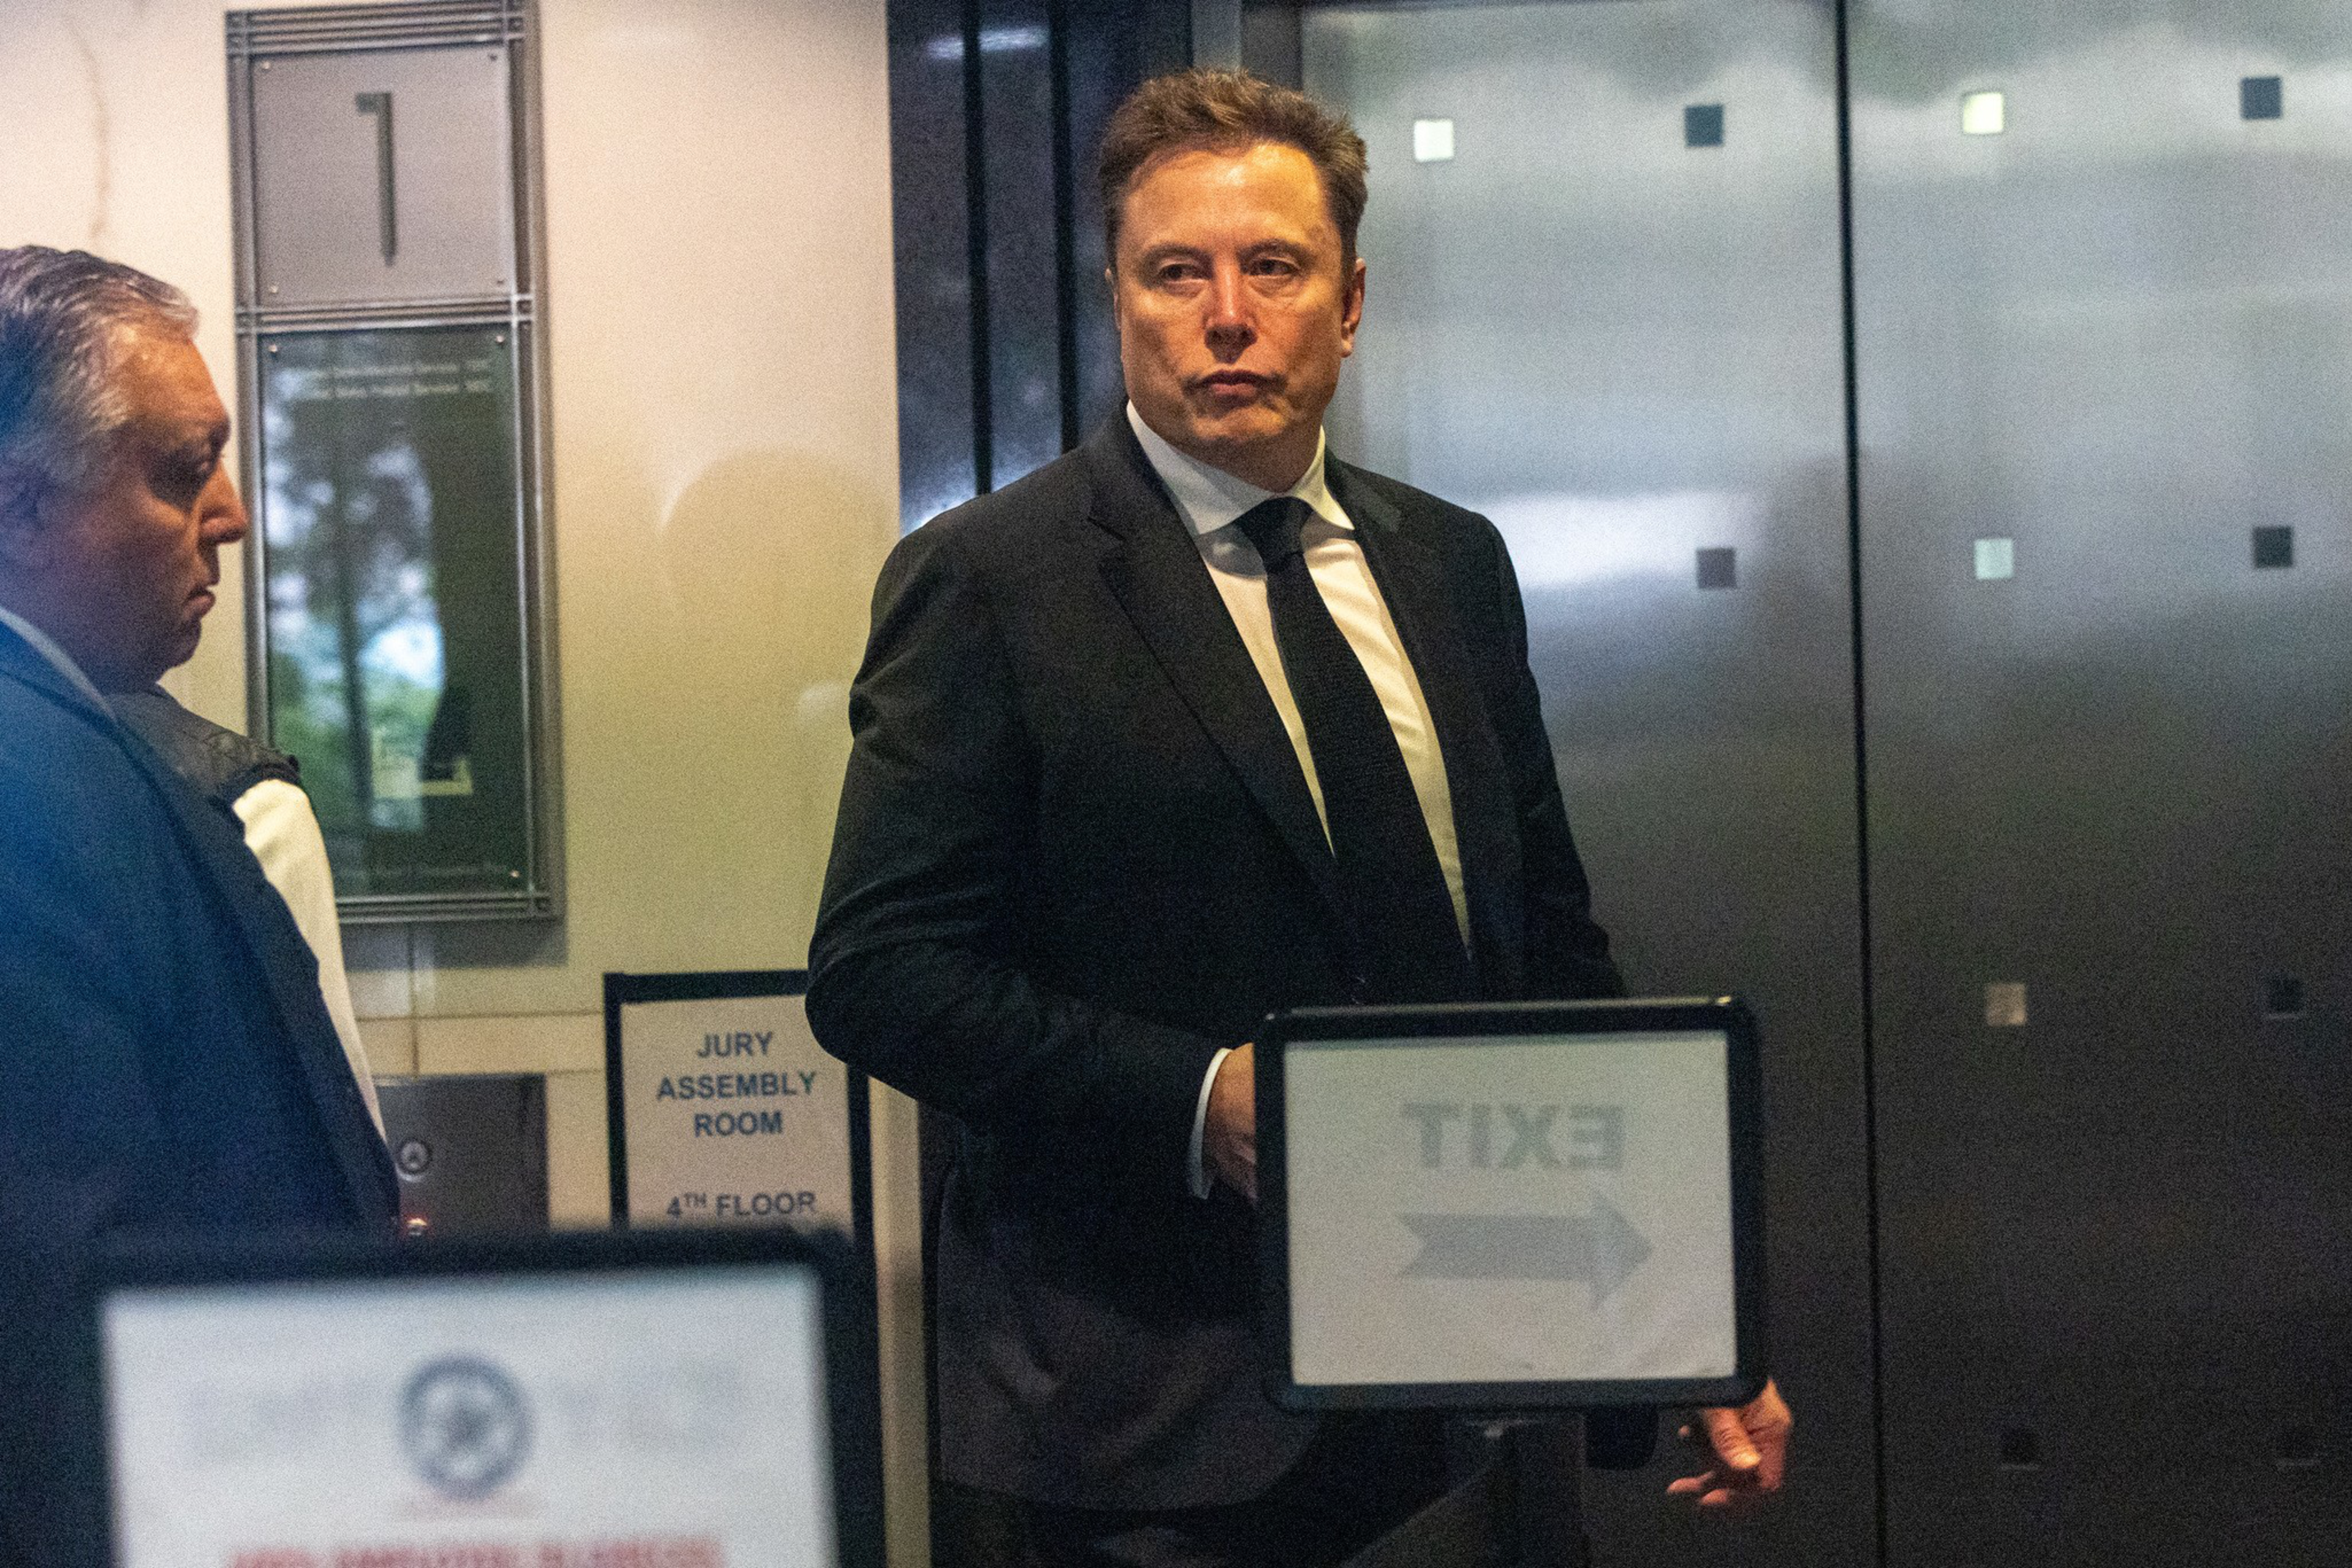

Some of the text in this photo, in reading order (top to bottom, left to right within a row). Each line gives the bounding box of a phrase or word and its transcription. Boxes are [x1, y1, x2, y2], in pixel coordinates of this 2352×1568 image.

[355, 92, 396, 267] 1
[697, 1031, 773, 1058] JURY
[656, 1071, 815, 1100] ASSEMBLY
[694, 1110, 782, 1137] ROOM
[667, 1191, 817, 1219] 4TH FLOOR
